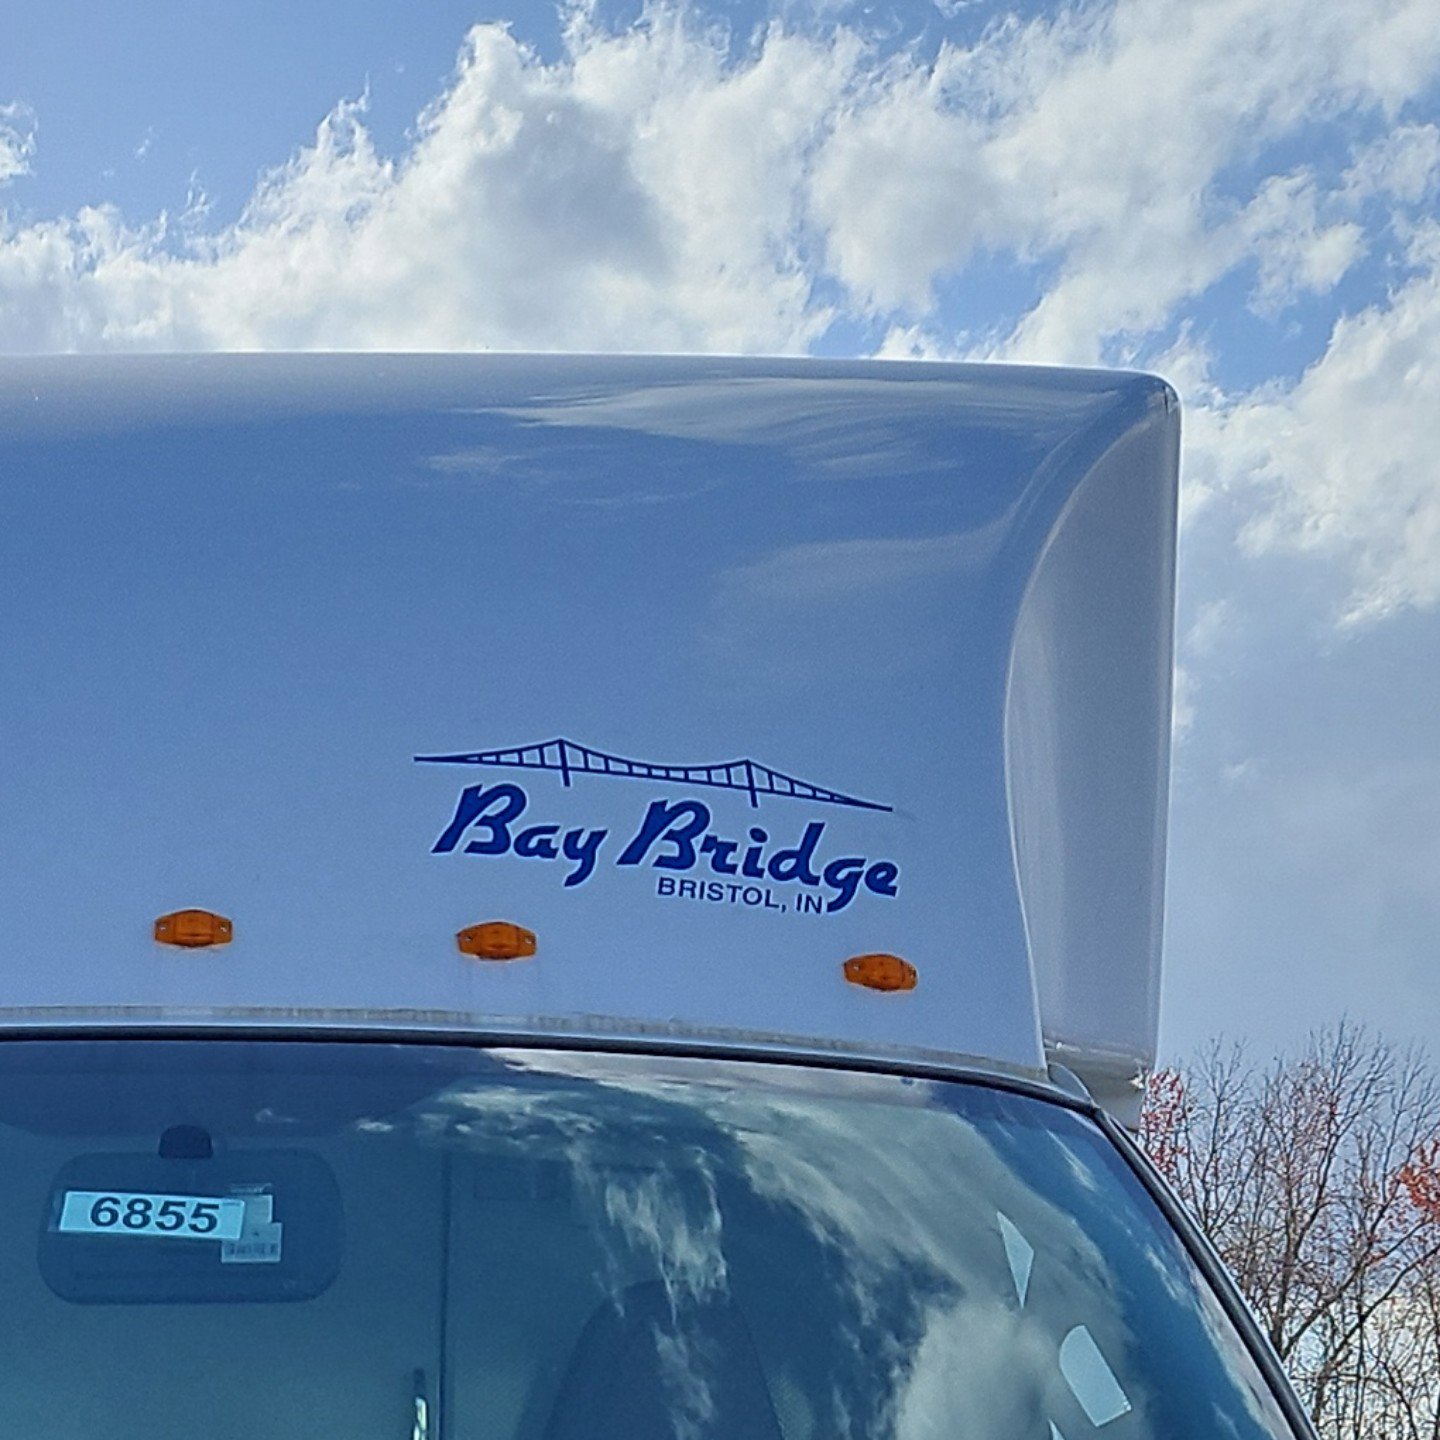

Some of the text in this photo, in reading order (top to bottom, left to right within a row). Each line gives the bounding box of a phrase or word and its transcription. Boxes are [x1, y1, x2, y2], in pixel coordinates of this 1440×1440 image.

[431, 784, 899, 913] Bay Bridge
[657, 877, 822, 914] BRISTOL, IN
[90, 1196, 220, 1233] 6855
